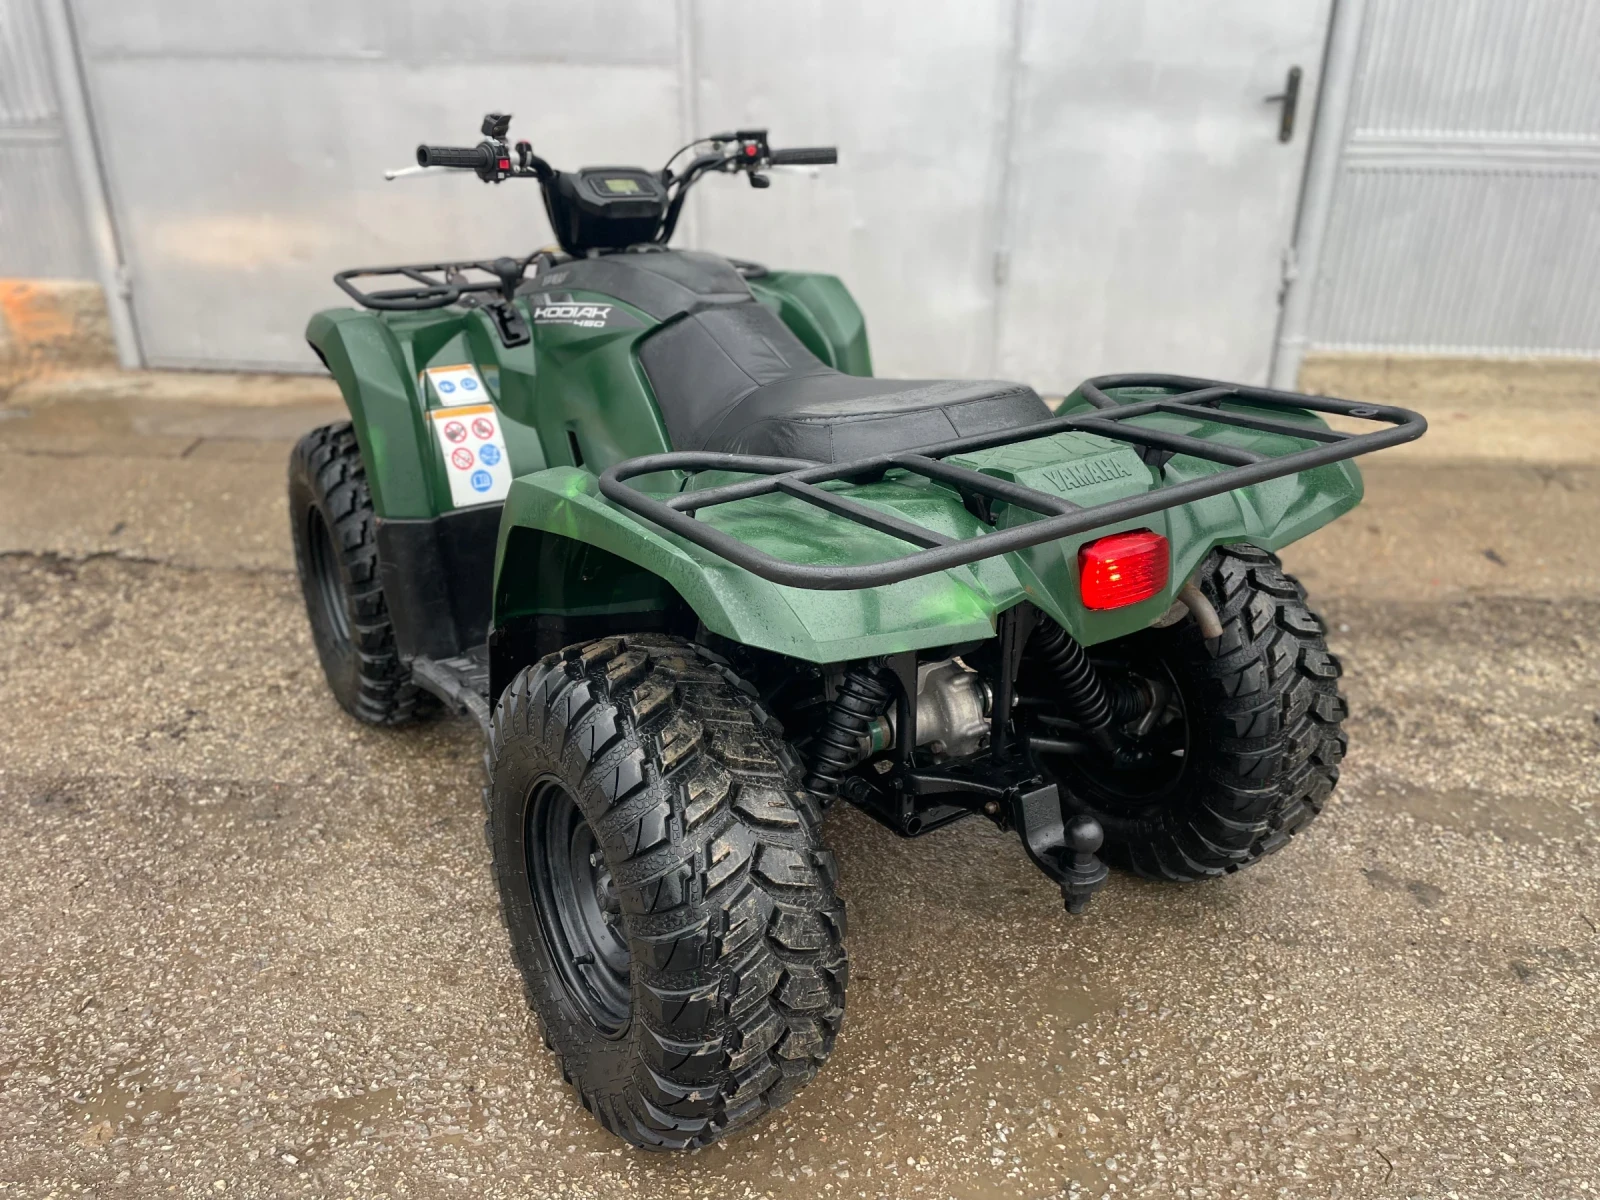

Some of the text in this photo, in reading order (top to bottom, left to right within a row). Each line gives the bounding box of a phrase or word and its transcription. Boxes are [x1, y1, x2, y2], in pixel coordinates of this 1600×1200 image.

[534, 306, 612, 319] KODIAK
[573, 319, 606, 328] 450
[1042, 458, 1132, 492] YAMAHA
